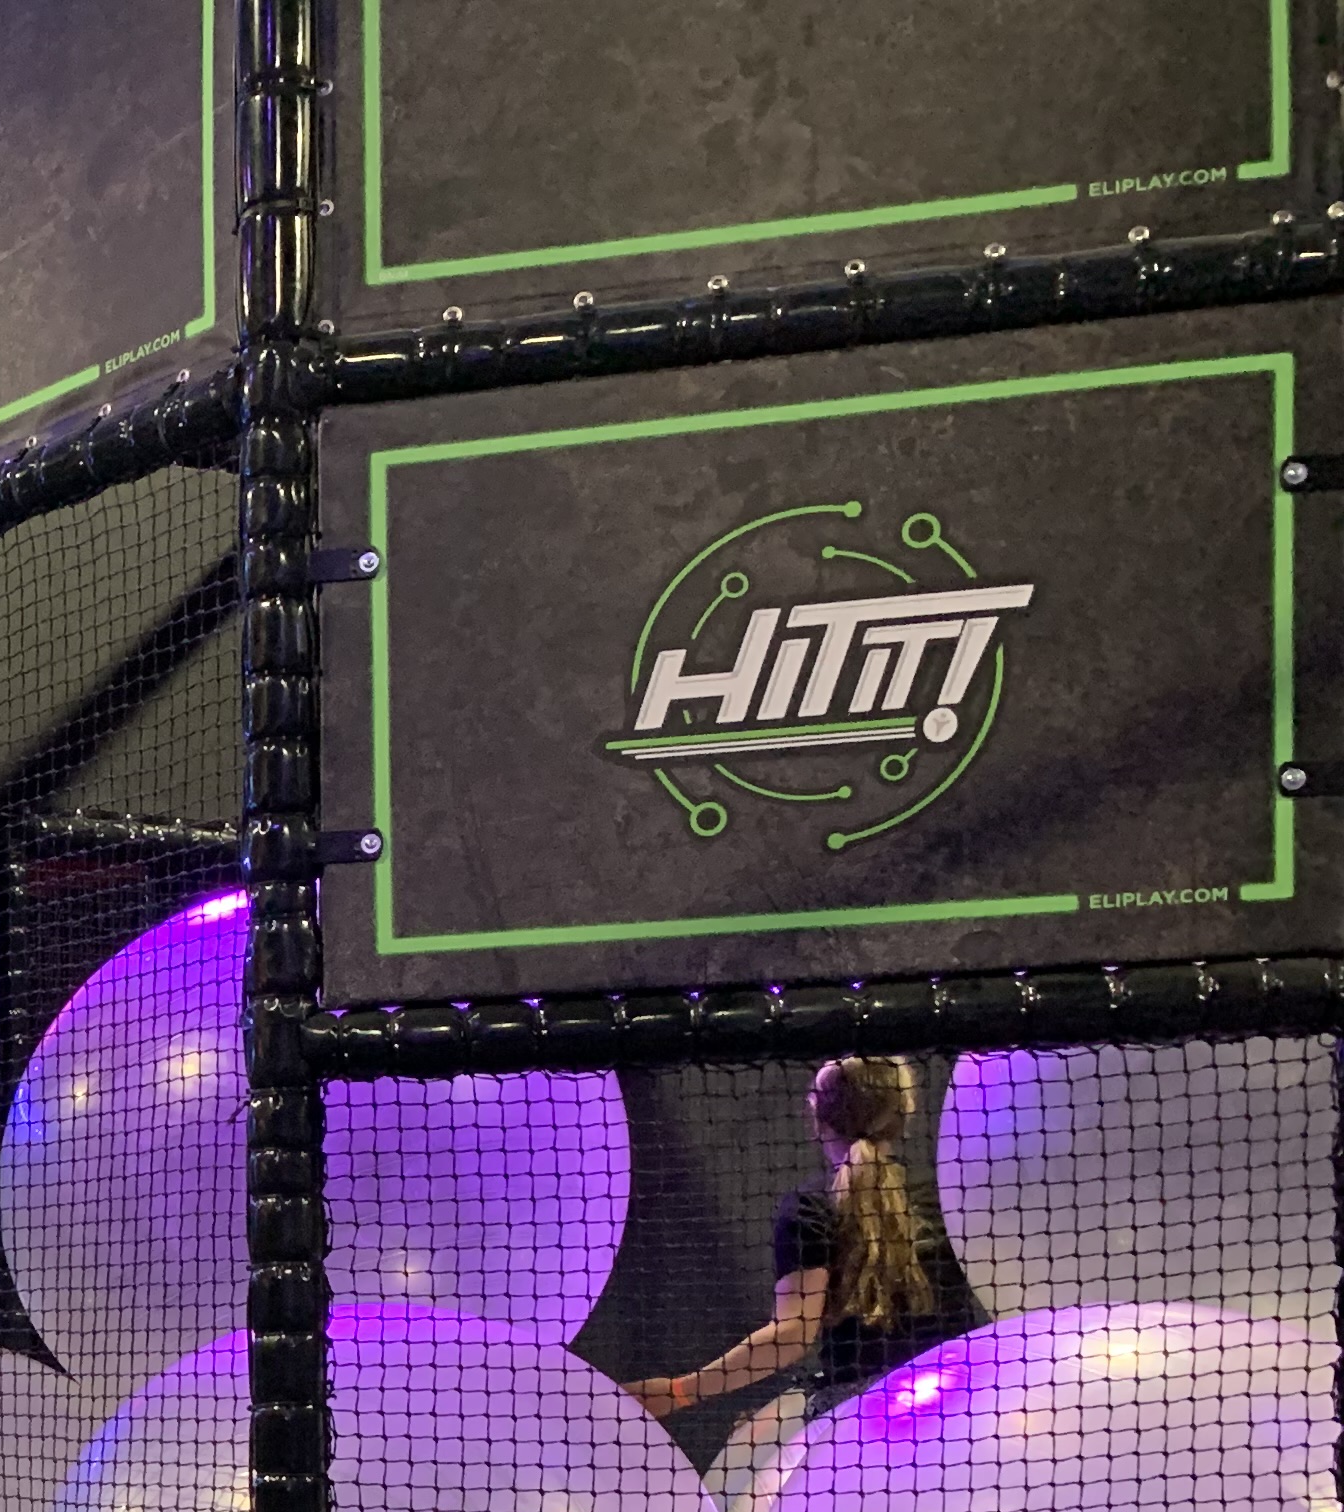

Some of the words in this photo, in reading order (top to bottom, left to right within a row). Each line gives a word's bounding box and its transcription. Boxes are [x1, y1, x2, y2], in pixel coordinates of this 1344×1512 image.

[1089, 166, 1227, 197] ELIPLAY.COM
[105, 329, 180, 374] ELIPLAY.COM
[1089, 887, 1228, 909] ELIPLAY.COM
